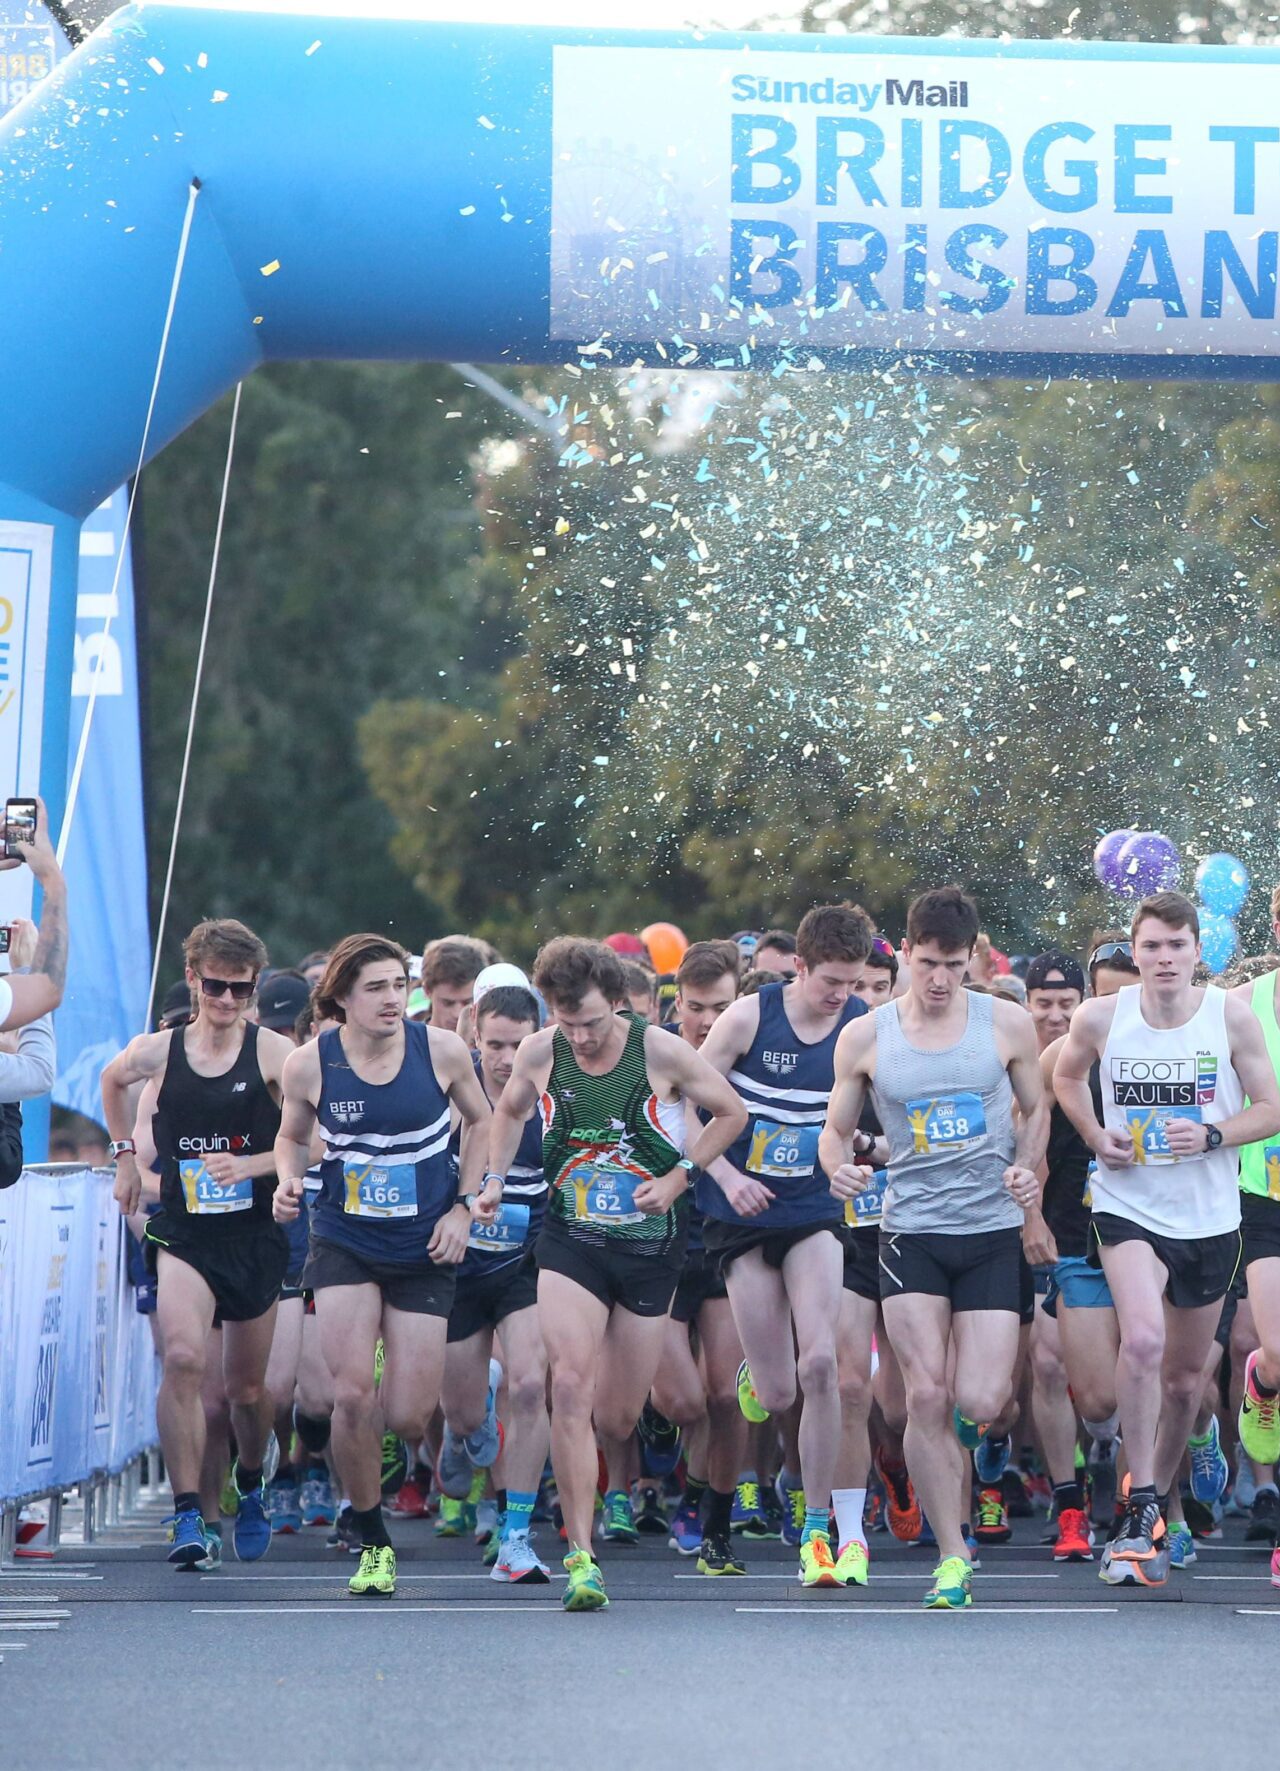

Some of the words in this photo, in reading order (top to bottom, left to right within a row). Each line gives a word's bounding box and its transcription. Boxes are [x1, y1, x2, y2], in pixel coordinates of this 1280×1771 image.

[731, 113, 1173, 214] BRIDGE
[762, 1050, 799, 1065] BERT
[1120, 1062, 1186, 1081] FOOT
[1115, 1085, 1192, 1104] FAULTS
[329, 1100, 365, 1113] BERT
[569, 1128, 621, 1143] PACE
[929, 1117, 969, 1140] 138
[1147, 1132, 1169, 1150] 13
[773, 1146, 799, 1163] 60
[362, 1186, 400, 1203] 166
[595, 1193, 622, 1211] 62
[856, 1194, 885, 1213] 12
